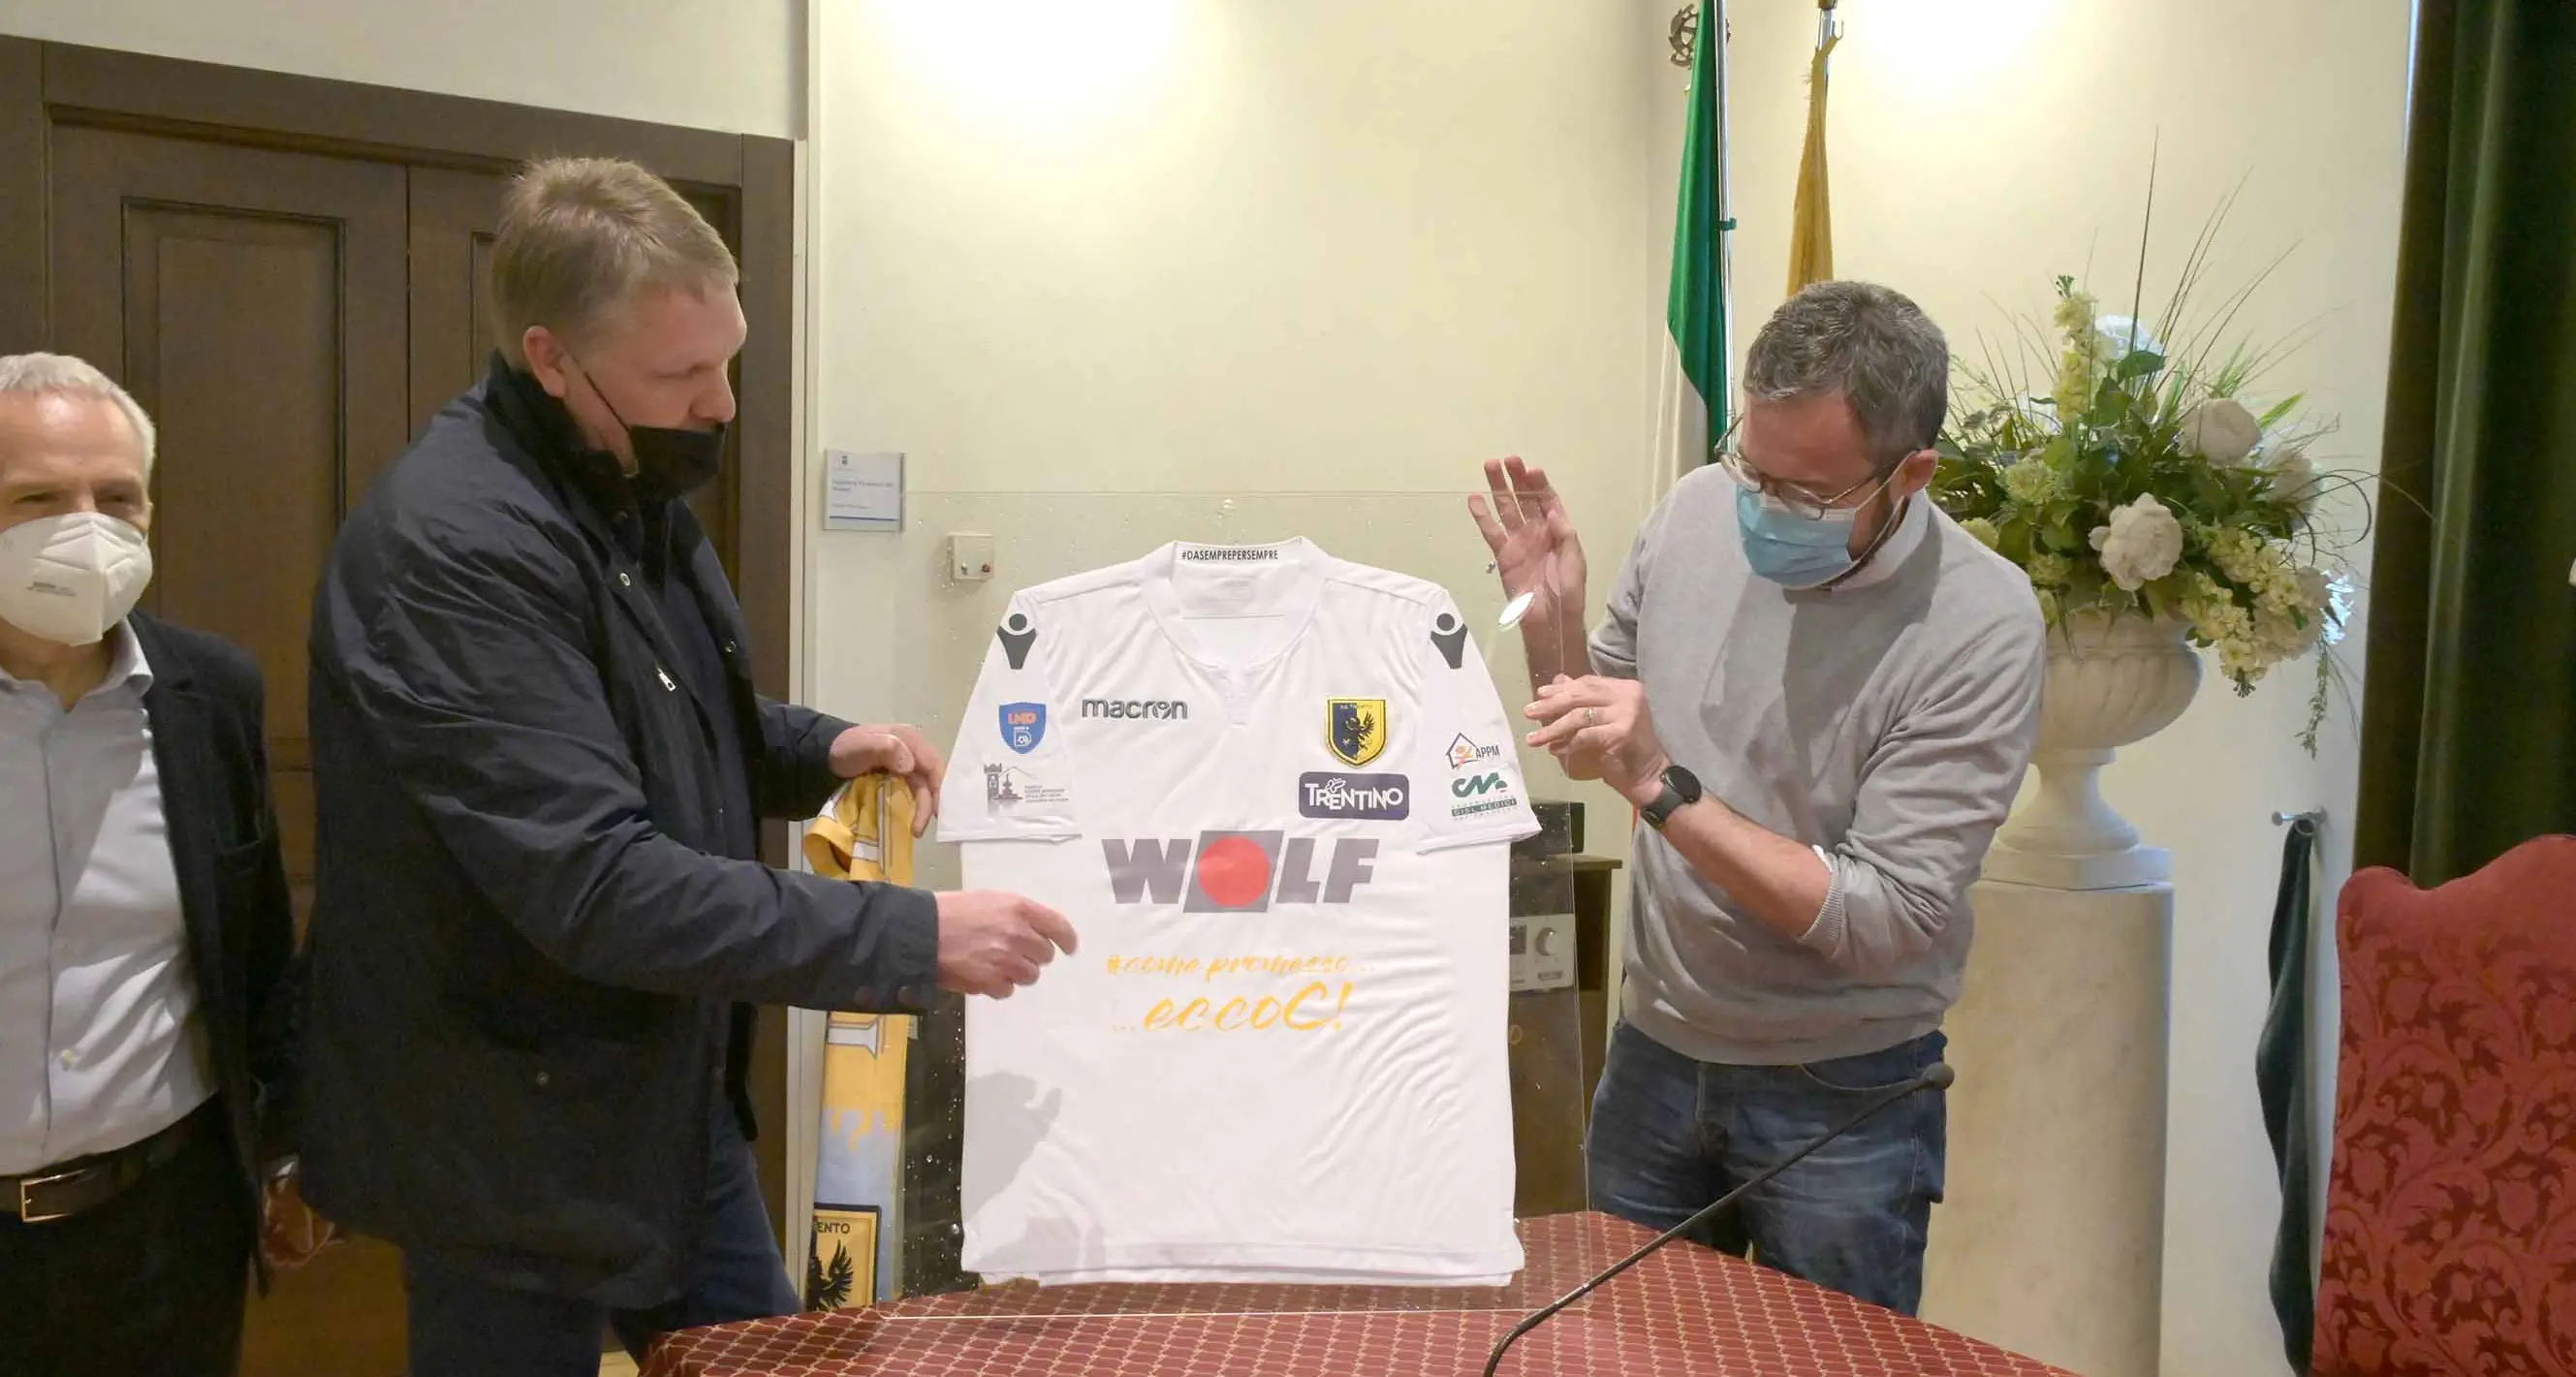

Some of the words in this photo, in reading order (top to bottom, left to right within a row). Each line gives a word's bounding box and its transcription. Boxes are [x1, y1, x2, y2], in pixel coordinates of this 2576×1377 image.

[1181, 549, 1278, 560] #DASEMPREPERSEMPRE
[1082, 699, 1188, 719] macron
[1475, 744, 1500, 759] APPM
[1304, 782, 1404, 811] TRENTINO
[1101, 830, 1380, 913] WOLF
[814, 1221, 850, 1235] ENTO
